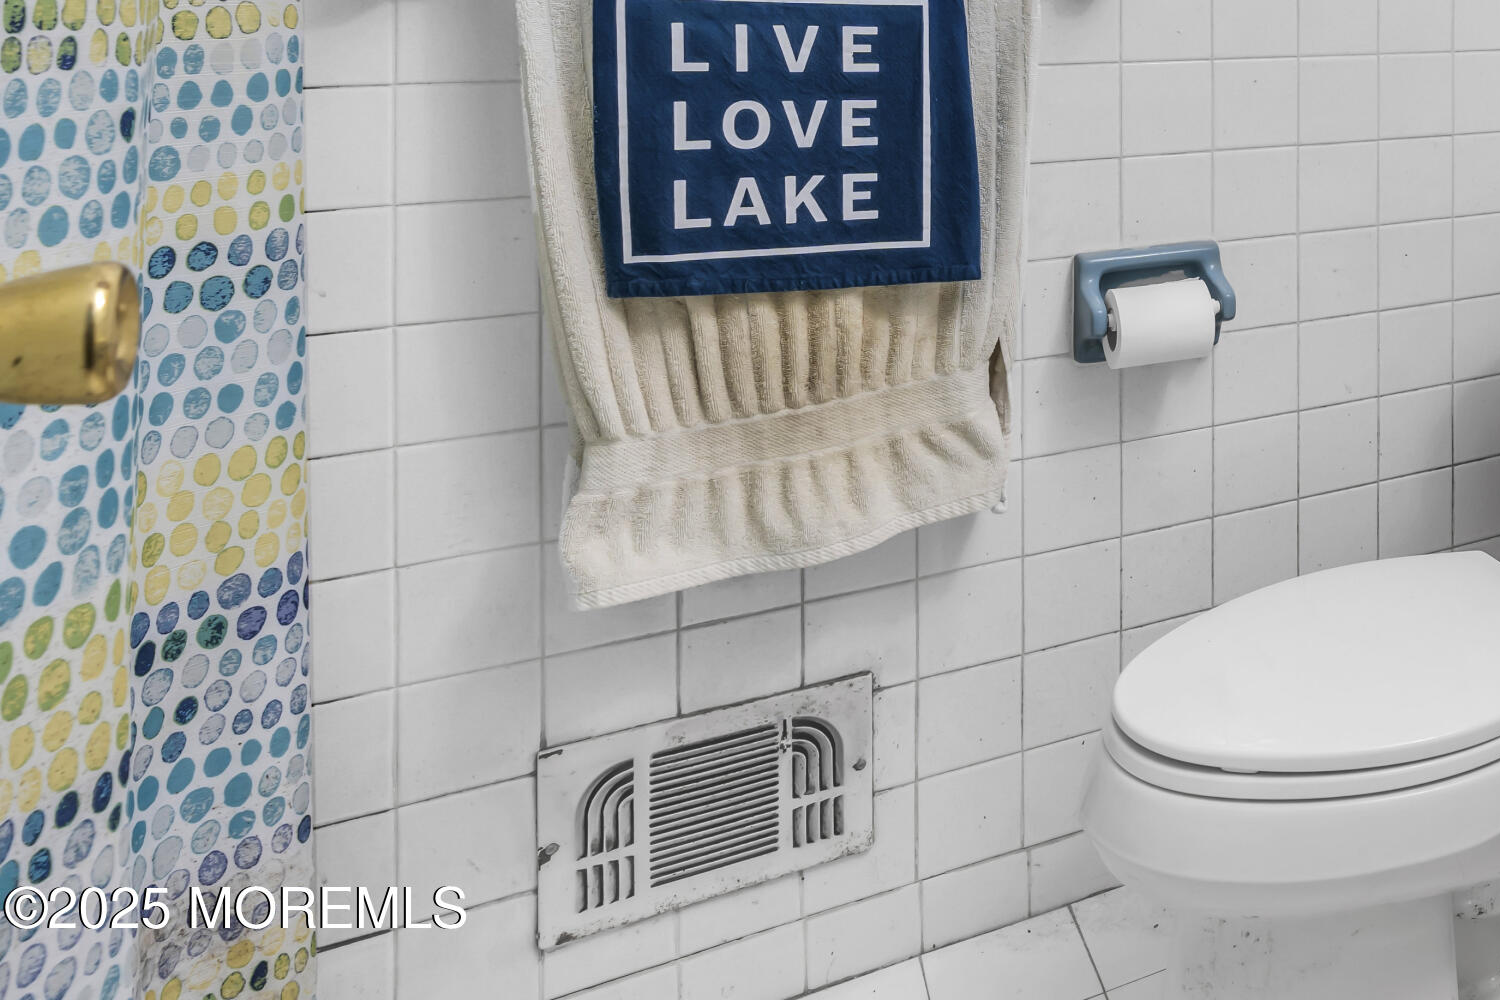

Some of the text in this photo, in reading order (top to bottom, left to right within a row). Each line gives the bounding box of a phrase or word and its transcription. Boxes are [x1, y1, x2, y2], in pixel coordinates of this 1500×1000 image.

[670, 22, 880, 73] LIVE
[673, 99, 880, 151] LOVE
[673, 172, 880, 230] LAKE
